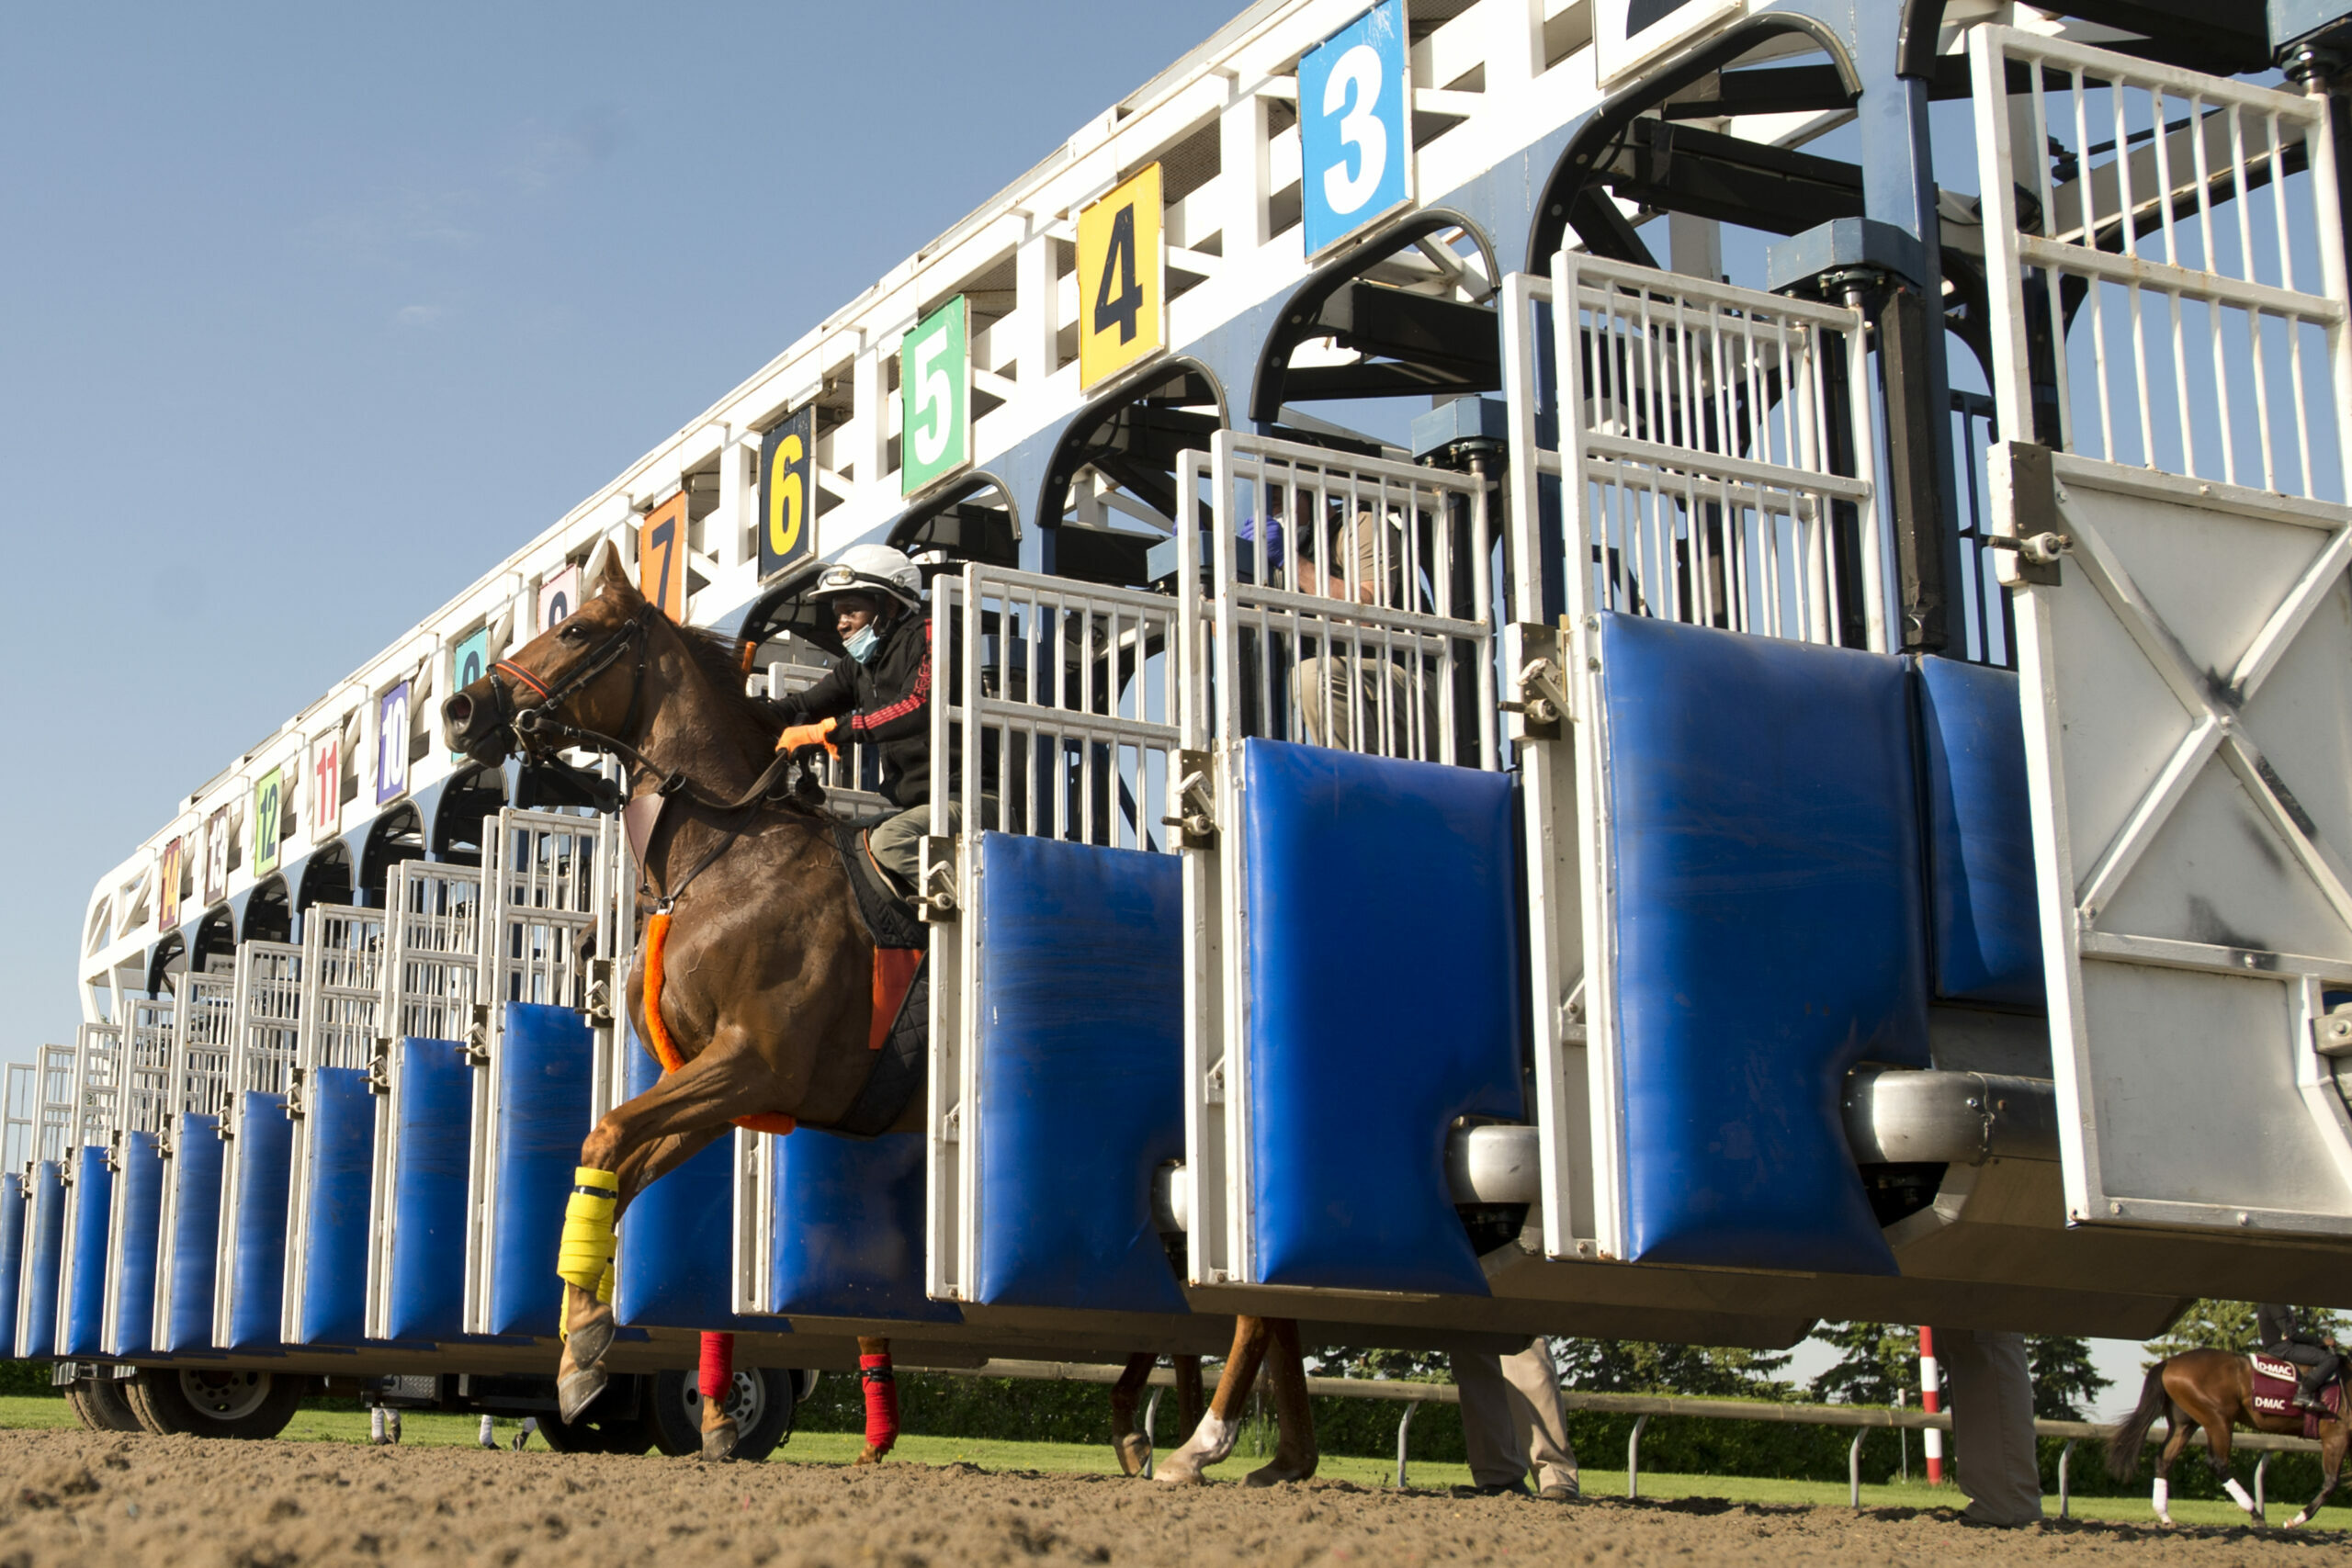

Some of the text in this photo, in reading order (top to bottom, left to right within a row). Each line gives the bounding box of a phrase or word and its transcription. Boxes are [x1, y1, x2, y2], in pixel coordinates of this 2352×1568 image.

[1323, 45, 1386, 214] 3
[1094, 202, 1143, 346] 4
[914, 326, 952, 465] 5
[769, 434, 803, 555] 6
[651, 515, 676, 611] 7
[317, 740, 337, 827] 11
[382, 697, 405, 791] 10
[209, 816, 227, 893] 13
[260, 783, 277, 863] 12
[163, 849, 179, 921] 14
